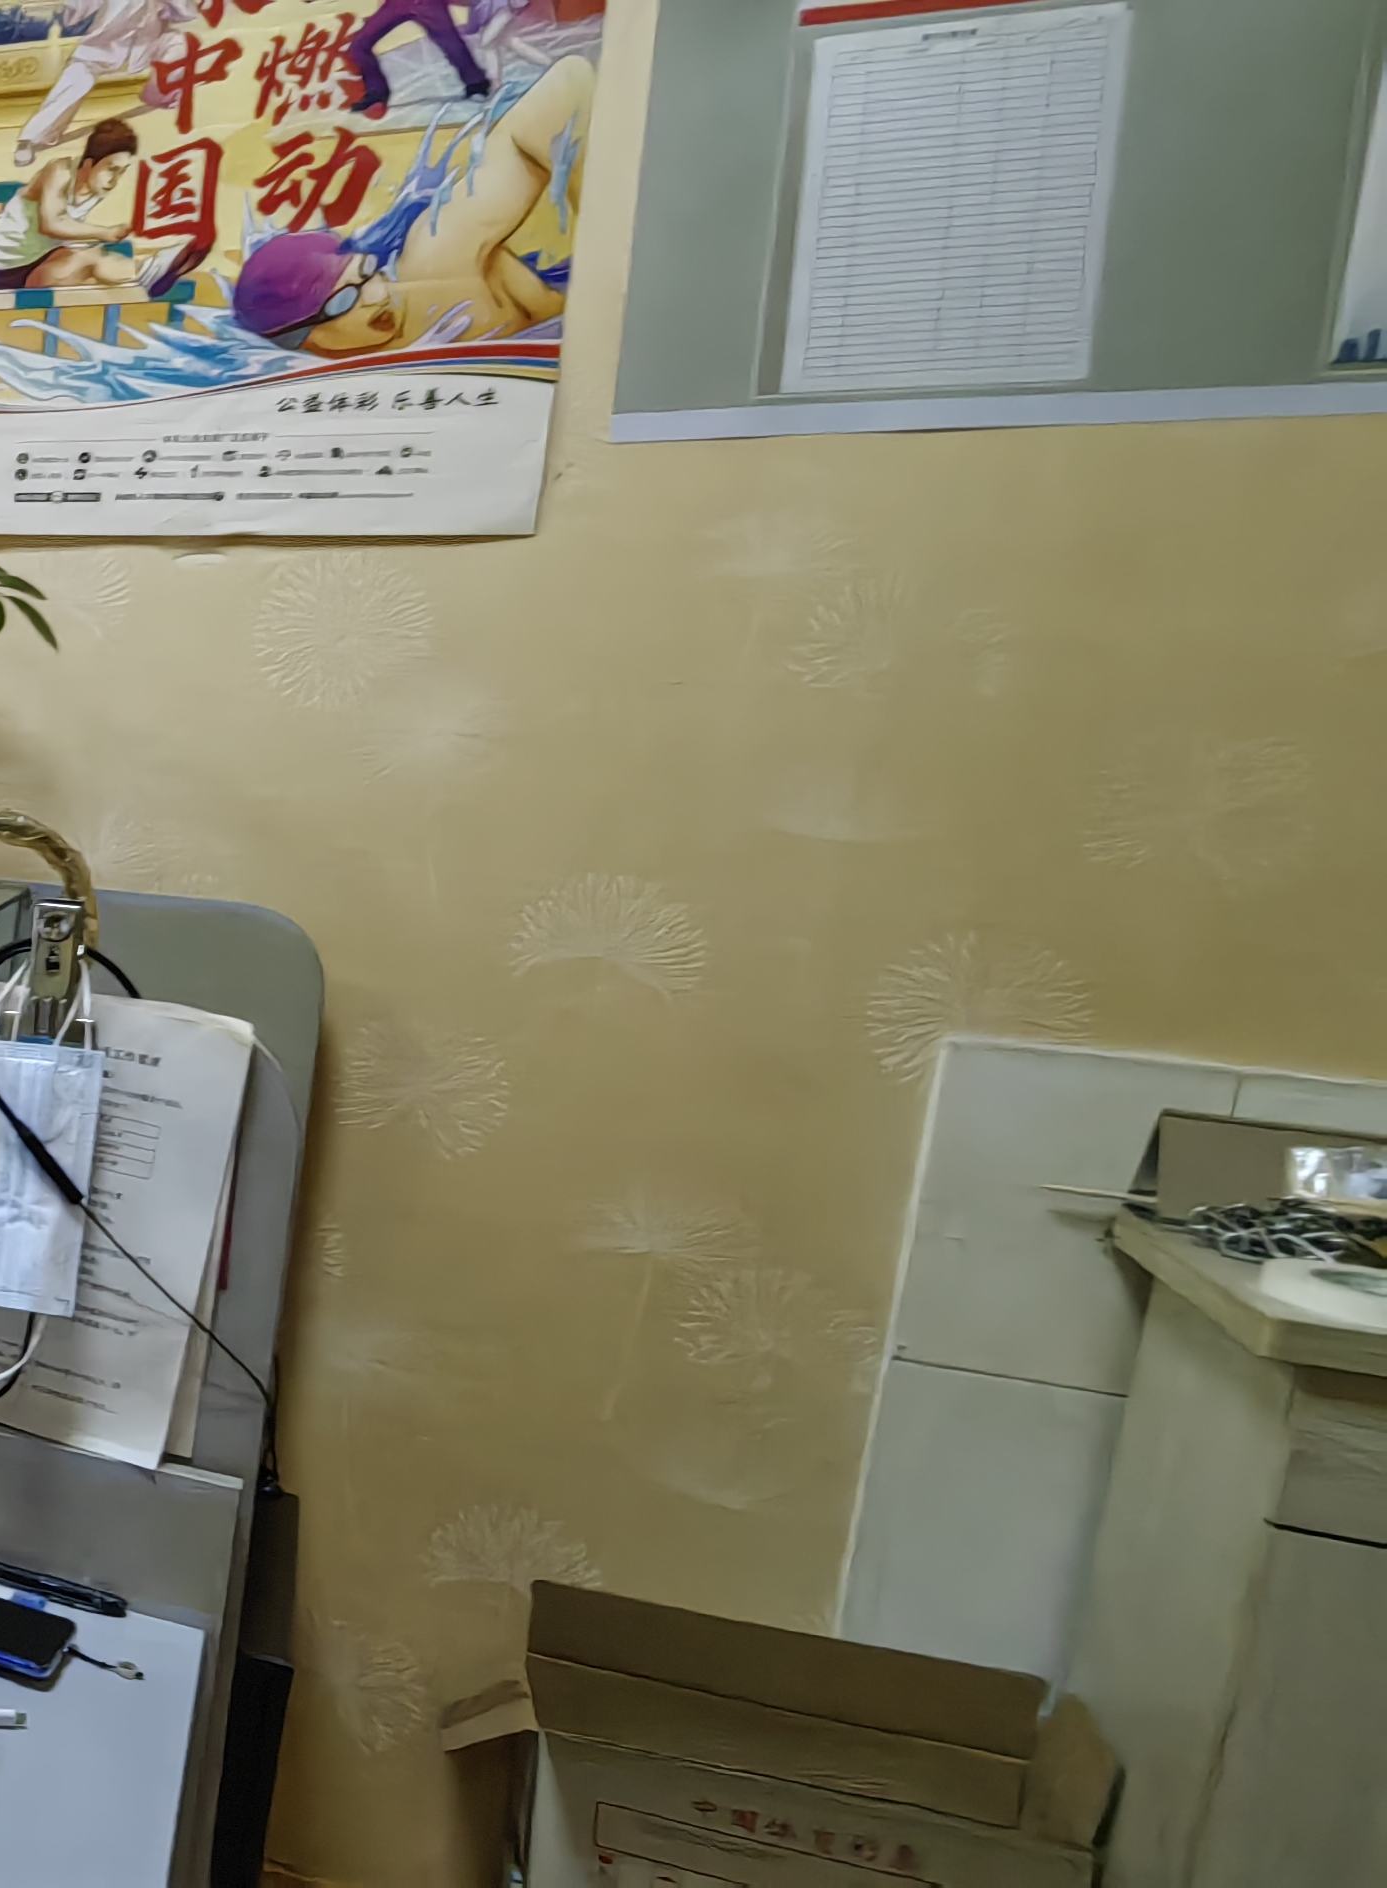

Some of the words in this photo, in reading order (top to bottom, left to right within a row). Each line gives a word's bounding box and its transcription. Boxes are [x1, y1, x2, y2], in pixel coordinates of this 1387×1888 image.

[132, 0, 274, 241] 中国
[253, 13, 383, 235] 燃动
[275, 392, 380, 416] 公益体彩
[390, 388, 502, 411] 乐善人生
